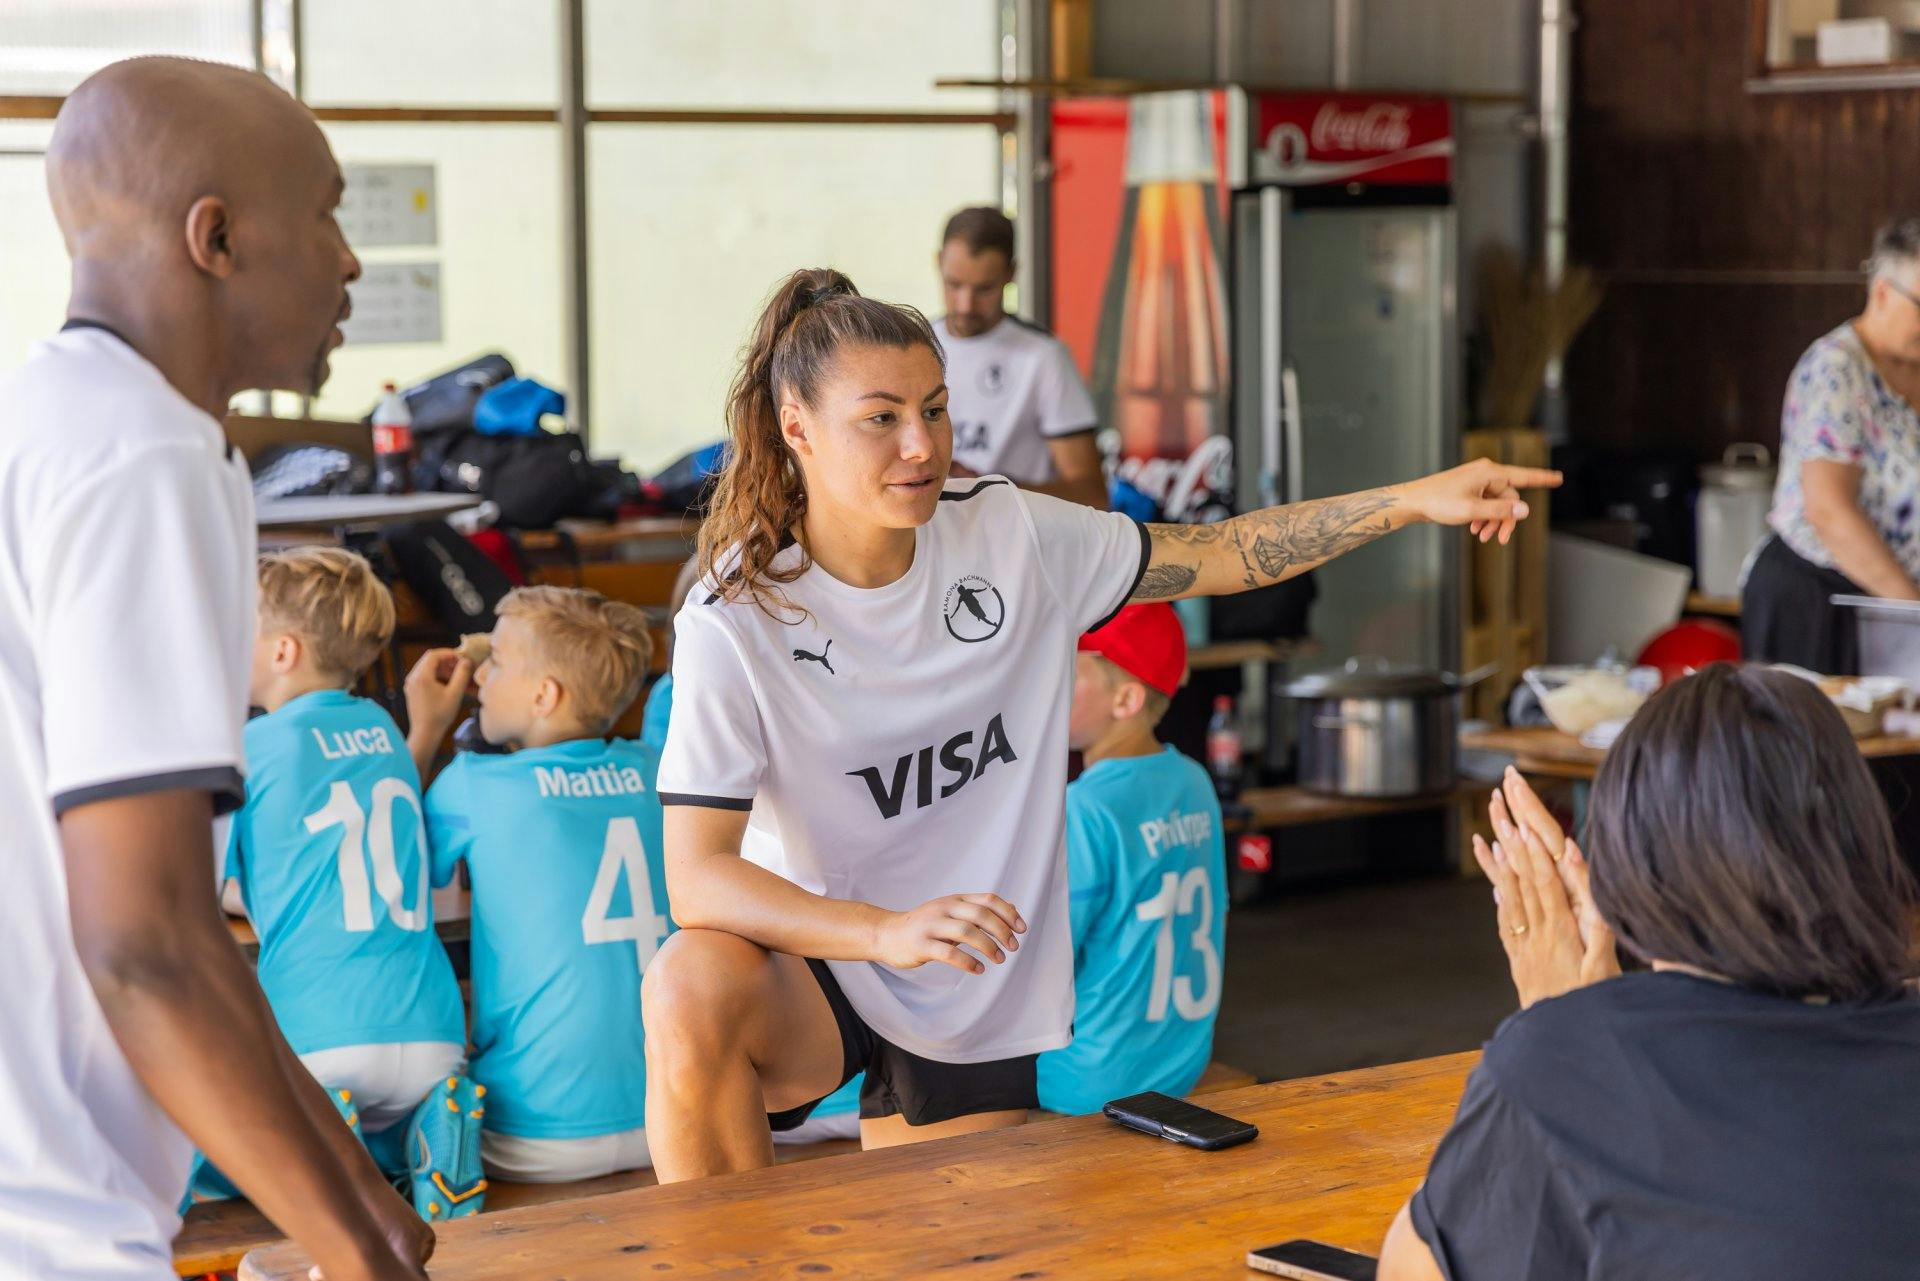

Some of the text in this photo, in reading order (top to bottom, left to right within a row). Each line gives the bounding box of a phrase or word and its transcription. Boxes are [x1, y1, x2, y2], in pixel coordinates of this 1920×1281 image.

[943, 574, 992, 612] RAMONA BACHMANN
[311, 726, 394, 760] Luca
[534, 762, 646, 798] Mattia
[845, 712, 1018, 820] VISA
[302, 776, 432, 932] 10
[581, 816, 669, 976] 4
[1135, 866, 1222, 1023] 13
